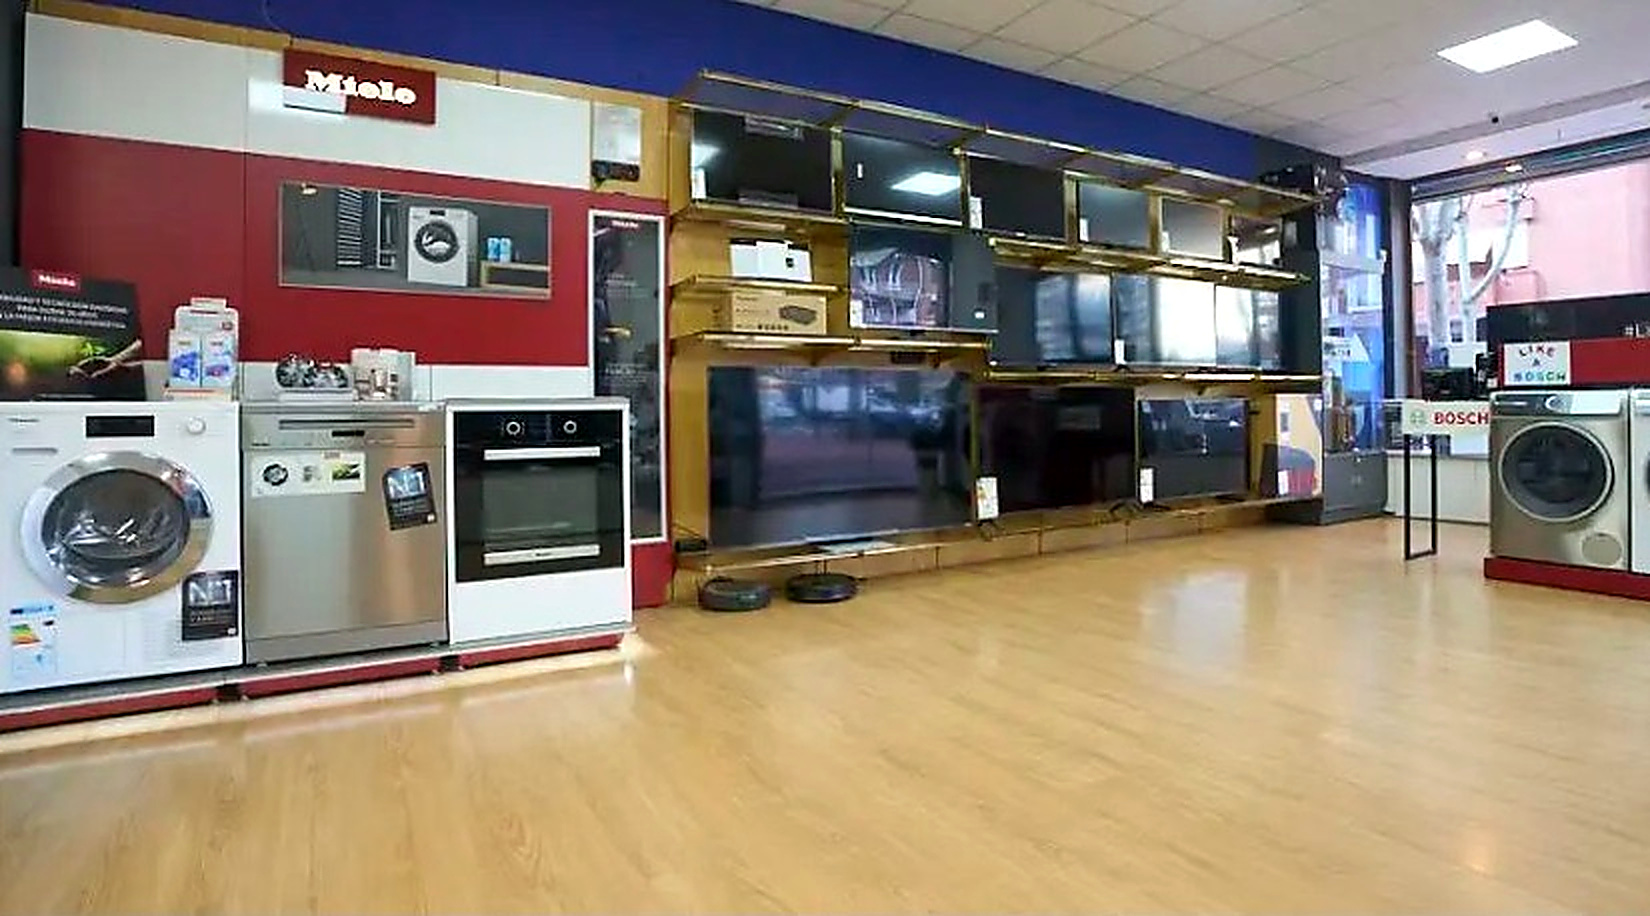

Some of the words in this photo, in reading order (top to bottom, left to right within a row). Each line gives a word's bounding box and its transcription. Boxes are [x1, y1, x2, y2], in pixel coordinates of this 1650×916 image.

[1519, 345, 1556, 358] LIKE
[1532, 358, 1541, 367] A
[1513, 371, 1566, 382] BOSCH
[1434, 411, 1489, 425] BOSCH
